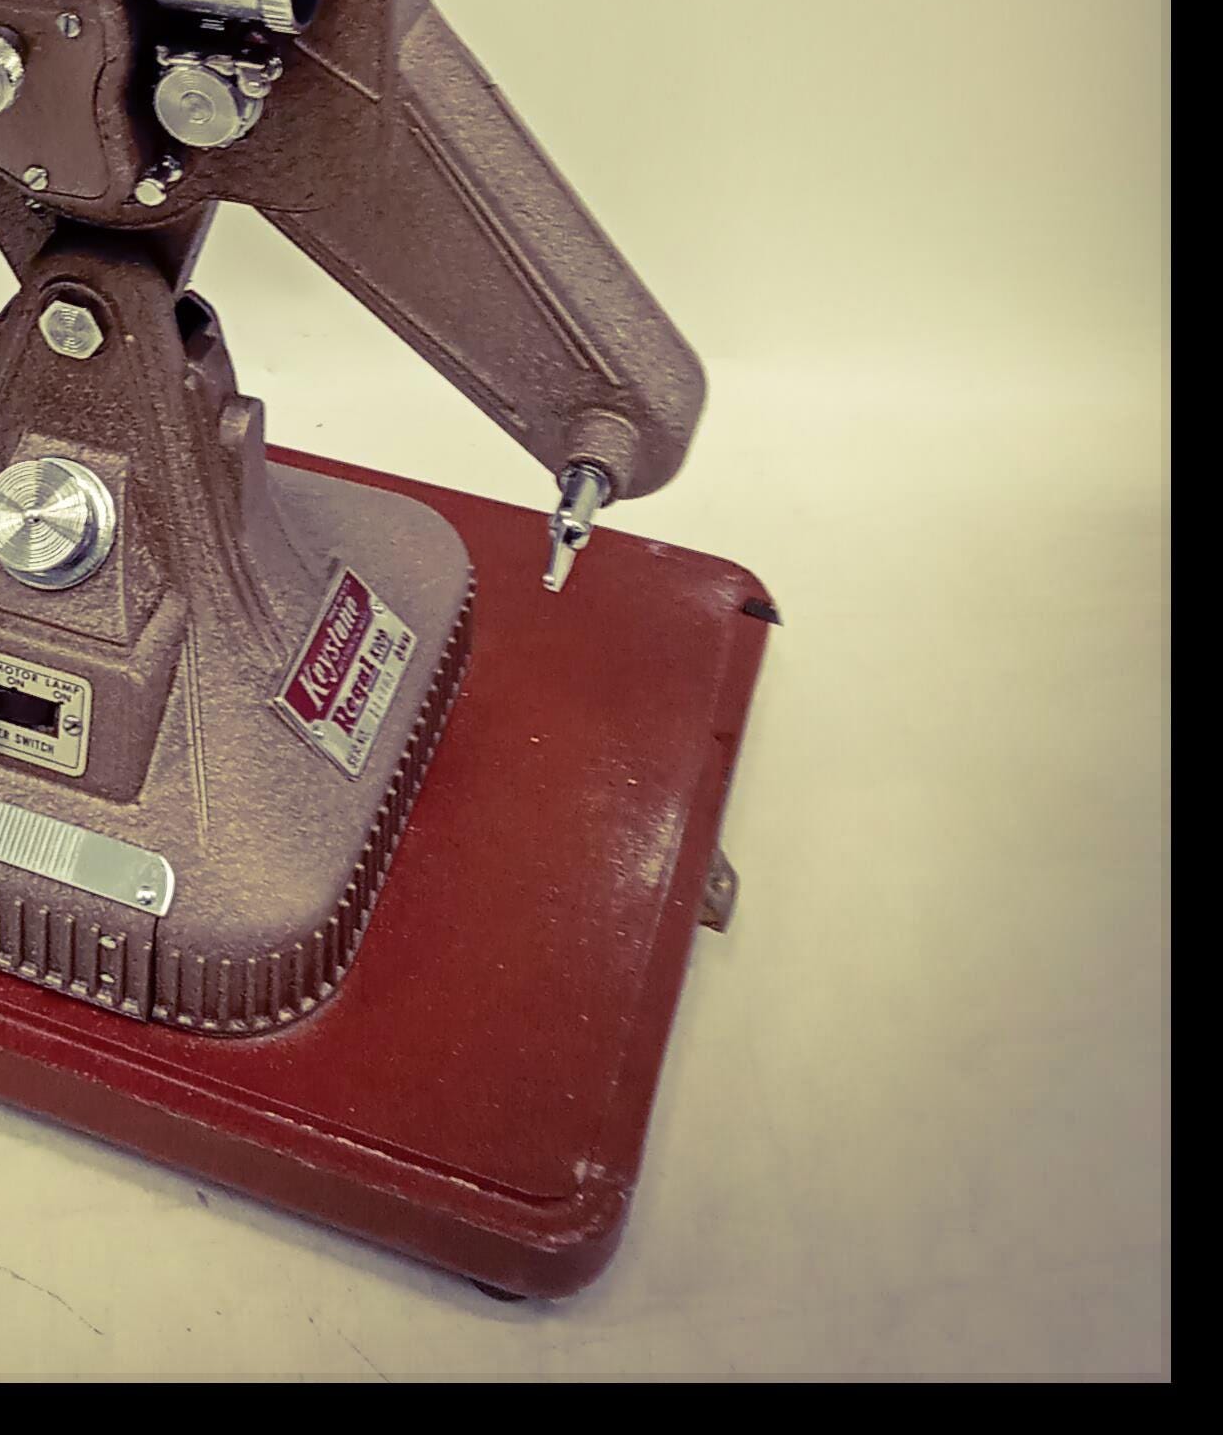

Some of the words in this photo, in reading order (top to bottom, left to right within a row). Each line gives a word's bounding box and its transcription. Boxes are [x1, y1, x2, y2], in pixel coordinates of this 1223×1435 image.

[299, 595, 359, 711] Keystone
[7, 676, 25, 688] ON
[45, 678, 81, 694] LAMP
[53, 690, 73, 702] ON
[332, 655, 376, 736] Regal
[15, 733, 55, 755] SWITCH
